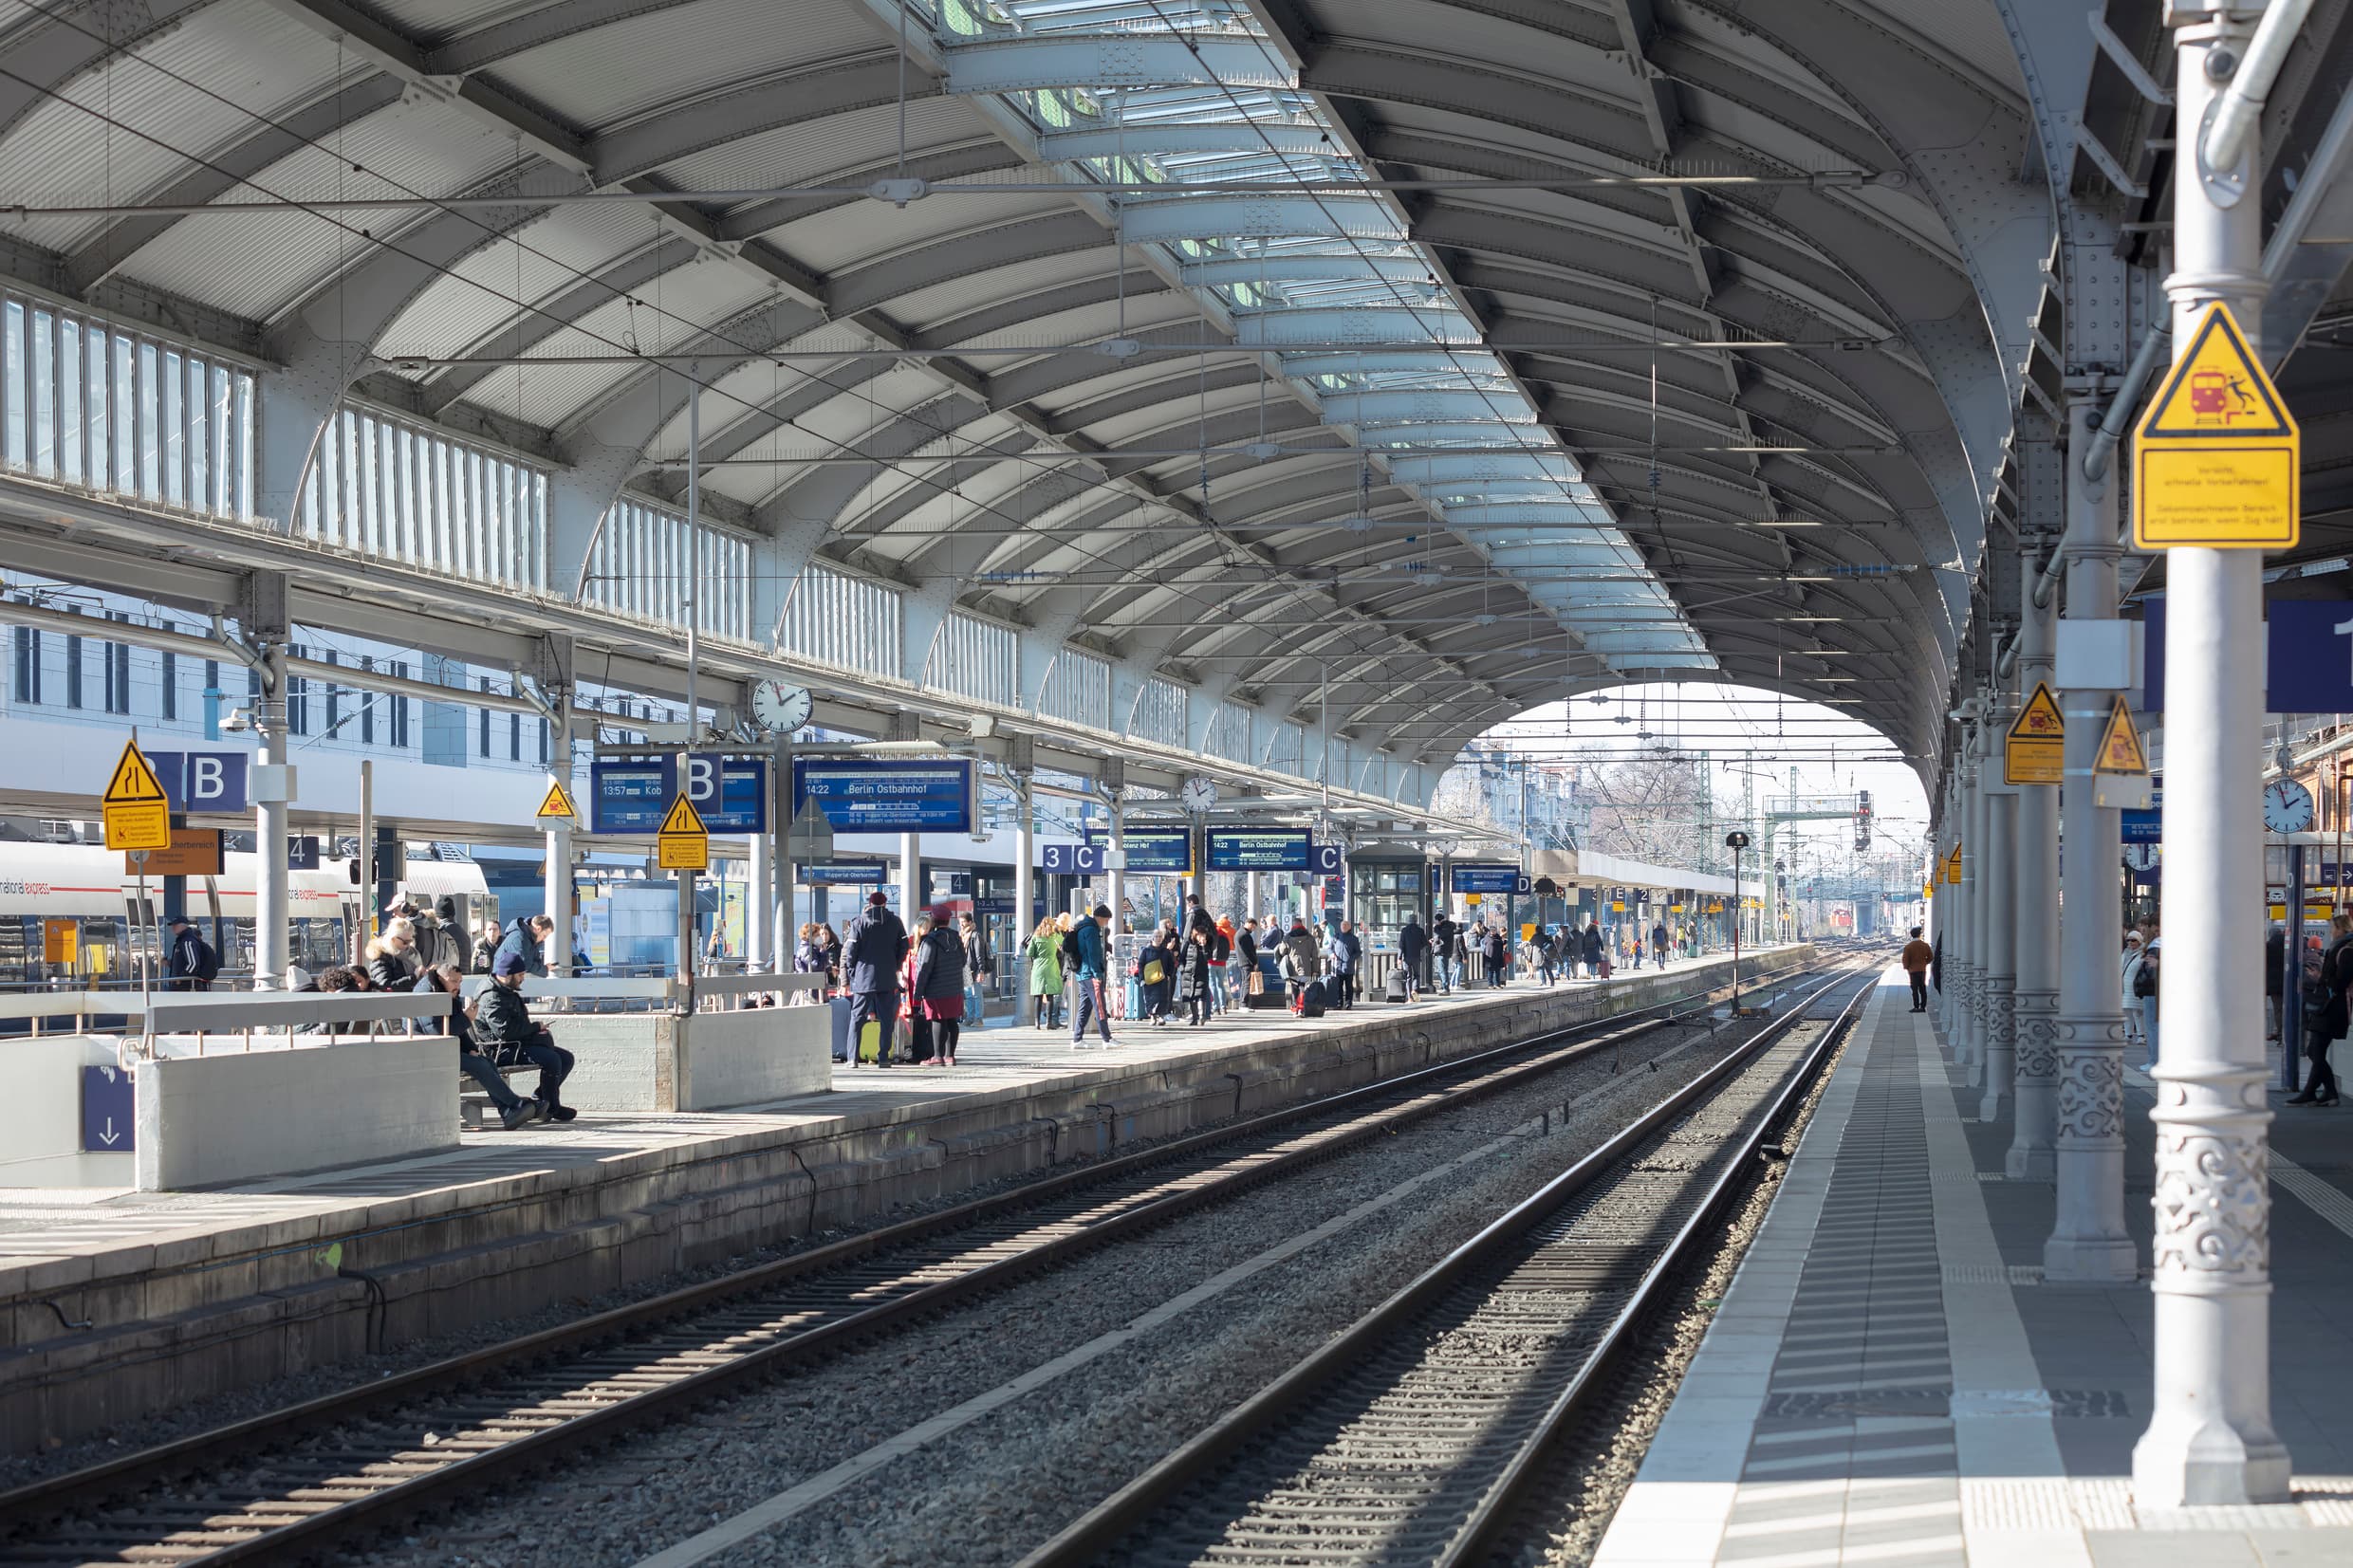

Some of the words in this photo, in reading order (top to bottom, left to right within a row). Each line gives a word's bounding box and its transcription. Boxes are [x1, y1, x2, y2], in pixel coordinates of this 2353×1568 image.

[195, 757, 225, 799] B
[689, 759, 714, 801] B
[603, 785, 626, 796] 13:57
[806, 784, 829, 795] 14:22
[848, 784, 874, 794] Berlin
[878, 784, 927, 794] Ostbahnhof
[289, 839, 306, 863] 4
[1047, 847, 1060, 868] 3
[1077, 846, 1093, 868] C
[1321, 847, 1337, 869] C
[25, 882, 50, 900] express
[953, 876, 964, 890] 4
[1518, 877, 1529, 892] D
[1616, 888, 1624, 899] E
[1640, 890, 1648, 900] 2
